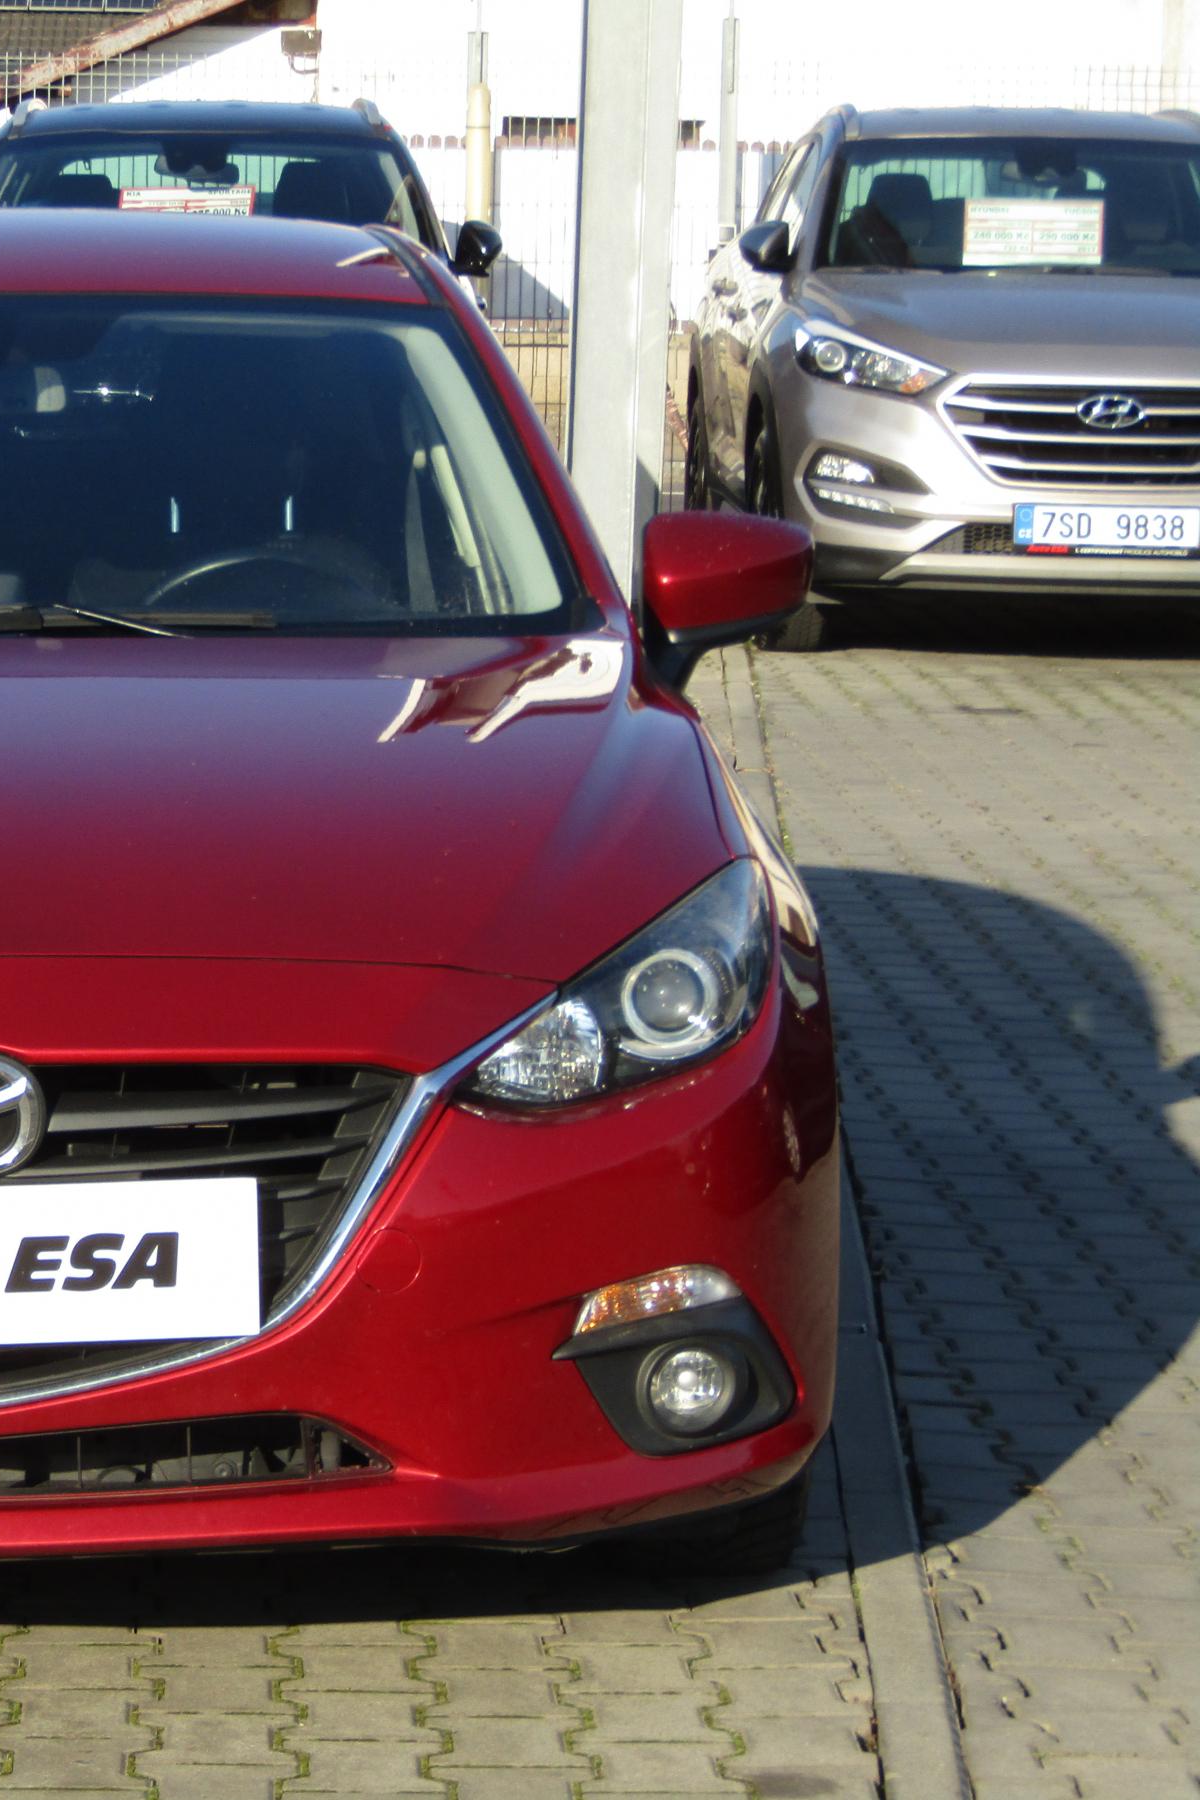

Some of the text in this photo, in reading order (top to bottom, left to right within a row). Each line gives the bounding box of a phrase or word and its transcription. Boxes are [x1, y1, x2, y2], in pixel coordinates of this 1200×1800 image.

[1018, 528, 1033, 539] CZ
[1041, 512, 1184, 541] 7SD 9838
[4, 1231, 179, 1293] ESA
